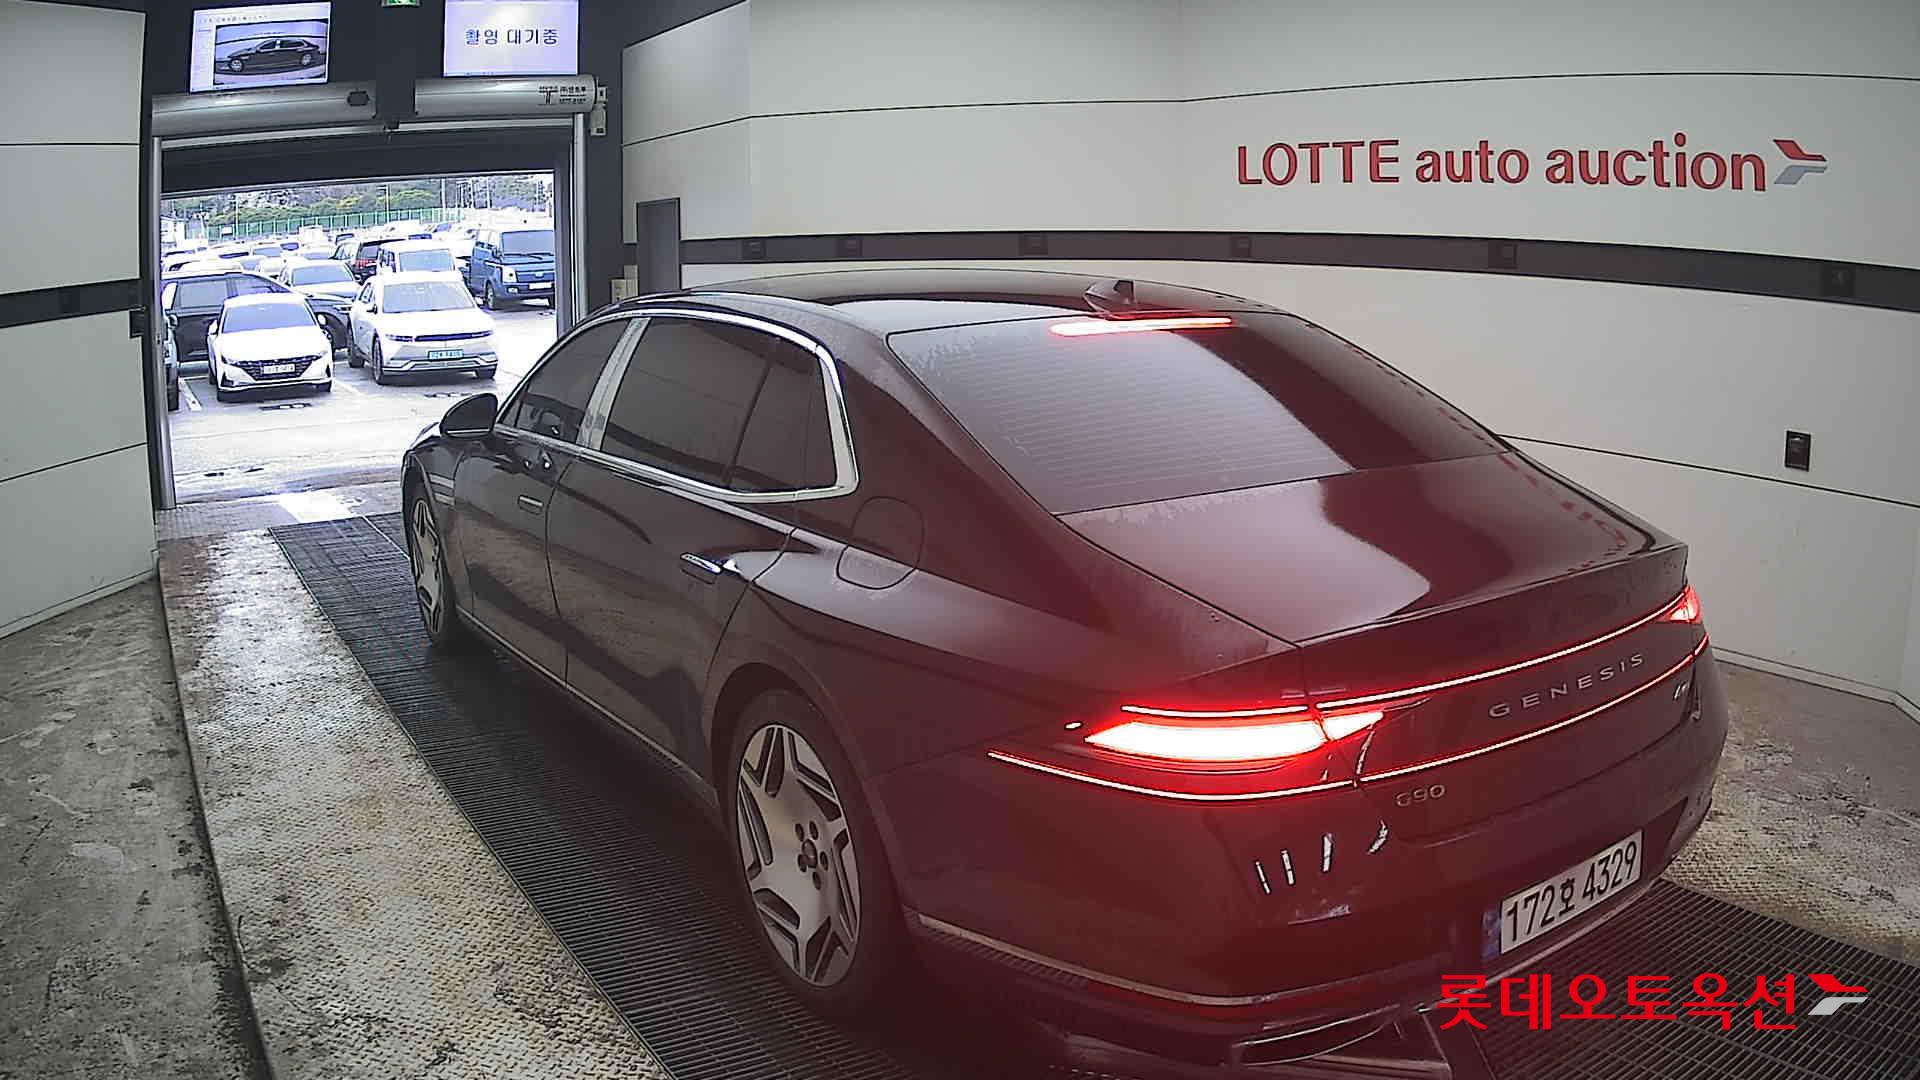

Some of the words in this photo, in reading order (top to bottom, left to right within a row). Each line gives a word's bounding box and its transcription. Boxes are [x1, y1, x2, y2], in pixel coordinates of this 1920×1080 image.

[507, 28, 559, 46] 대기중
[1238, 139, 1400, 185] LOTTE
[1416, 141, 1530, 185] auto
[1546, 133, 1767, 193] auction
[1488, 654, 1644, 718] GENESIS
[1396, 784, 1446, 807] G90
[1506, 878, 1576, 942] 172호
[1582, 840, 1638, 902] 4329
